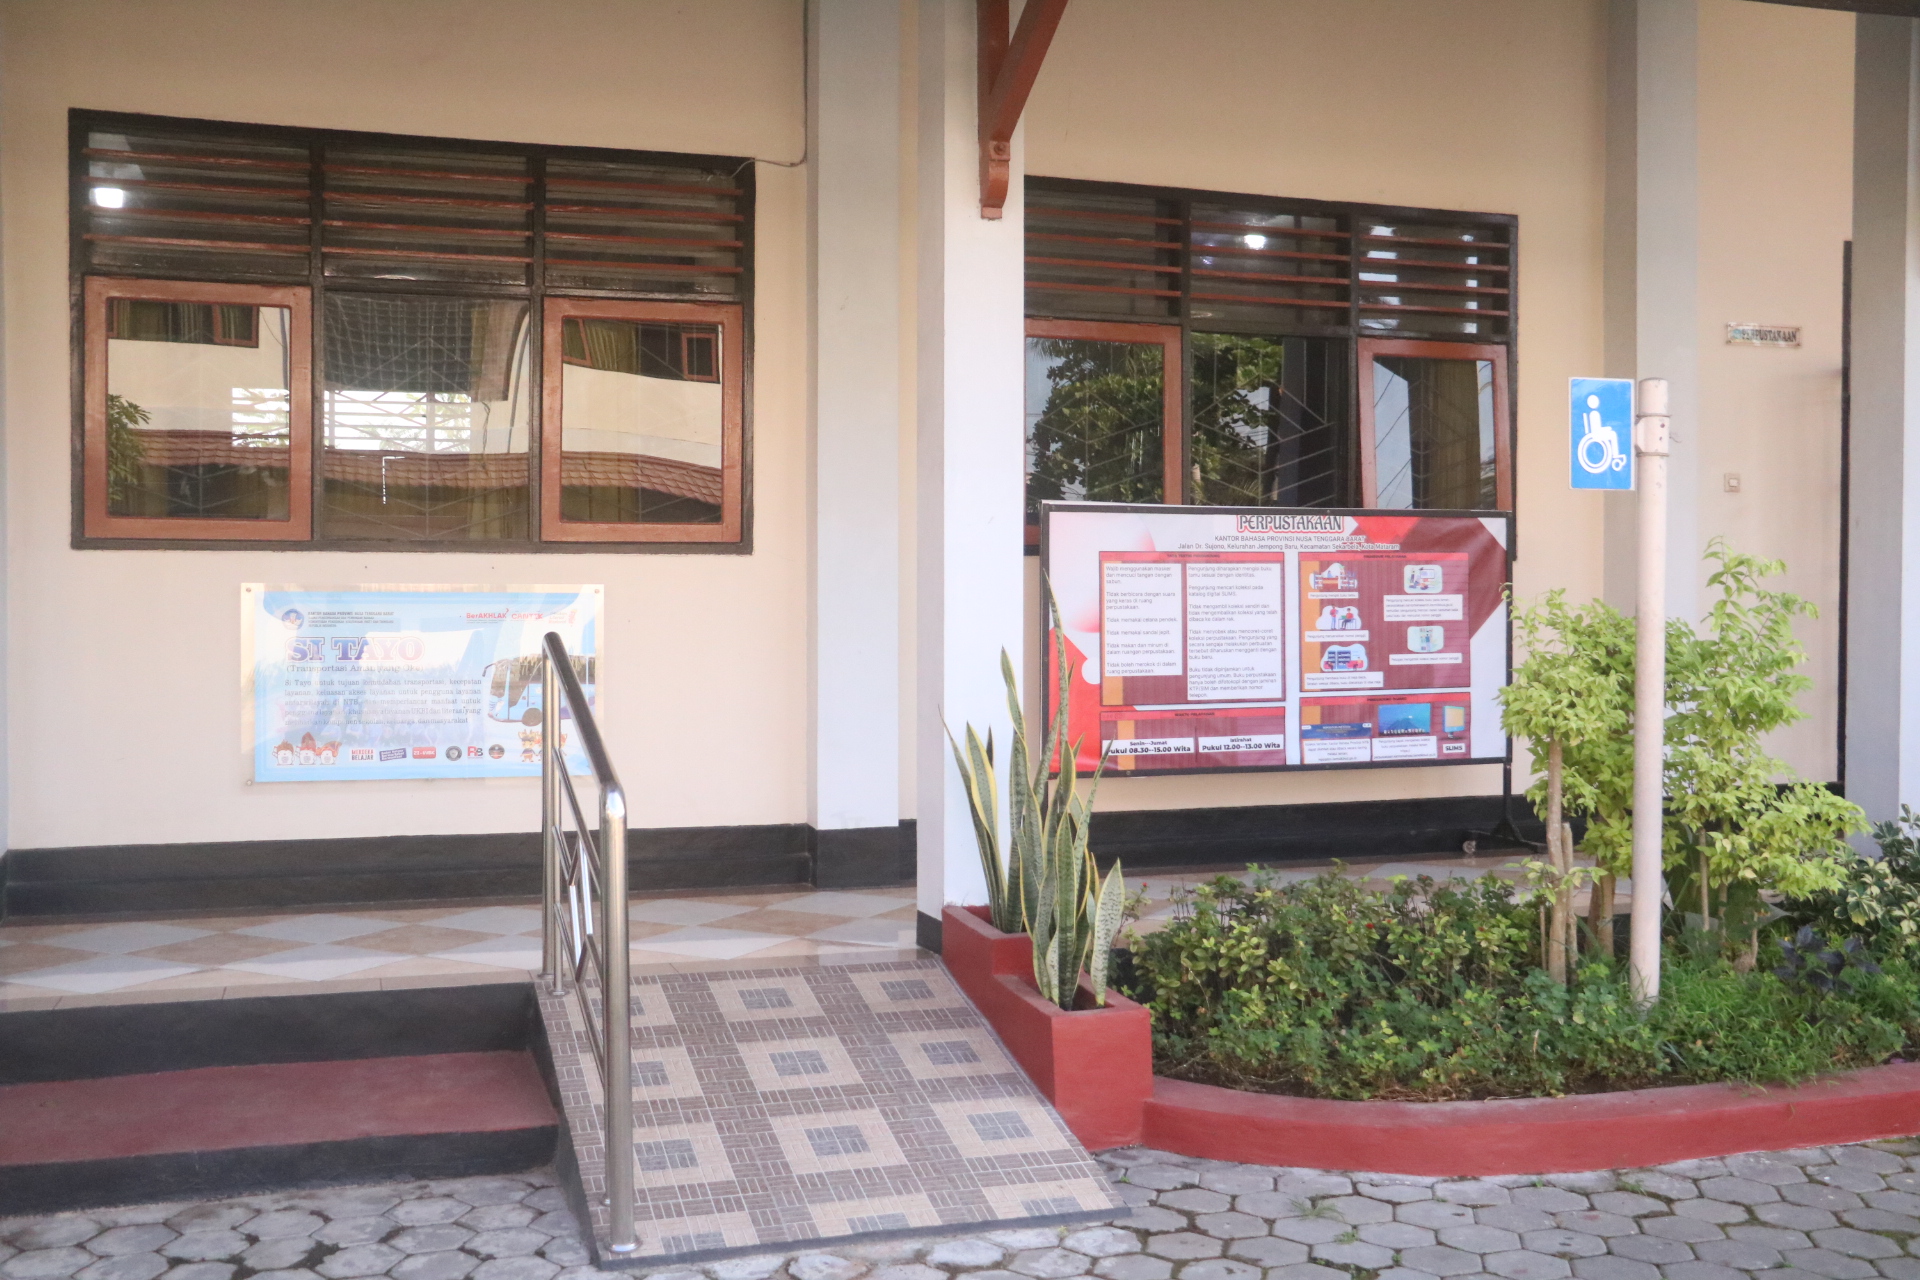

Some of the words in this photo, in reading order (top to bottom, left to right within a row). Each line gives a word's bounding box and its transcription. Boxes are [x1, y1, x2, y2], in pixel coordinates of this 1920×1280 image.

[1239, 515, 1342, 531] PERPUSTAKAAN
[285, 637, 325, 662] SI
[331, 637, 425, 662] TAYO
[286, 665, 347, 673] (Transportasi
[294, 679, 311, 687] Tayo
[338, 679, 360, 687] tujuan
